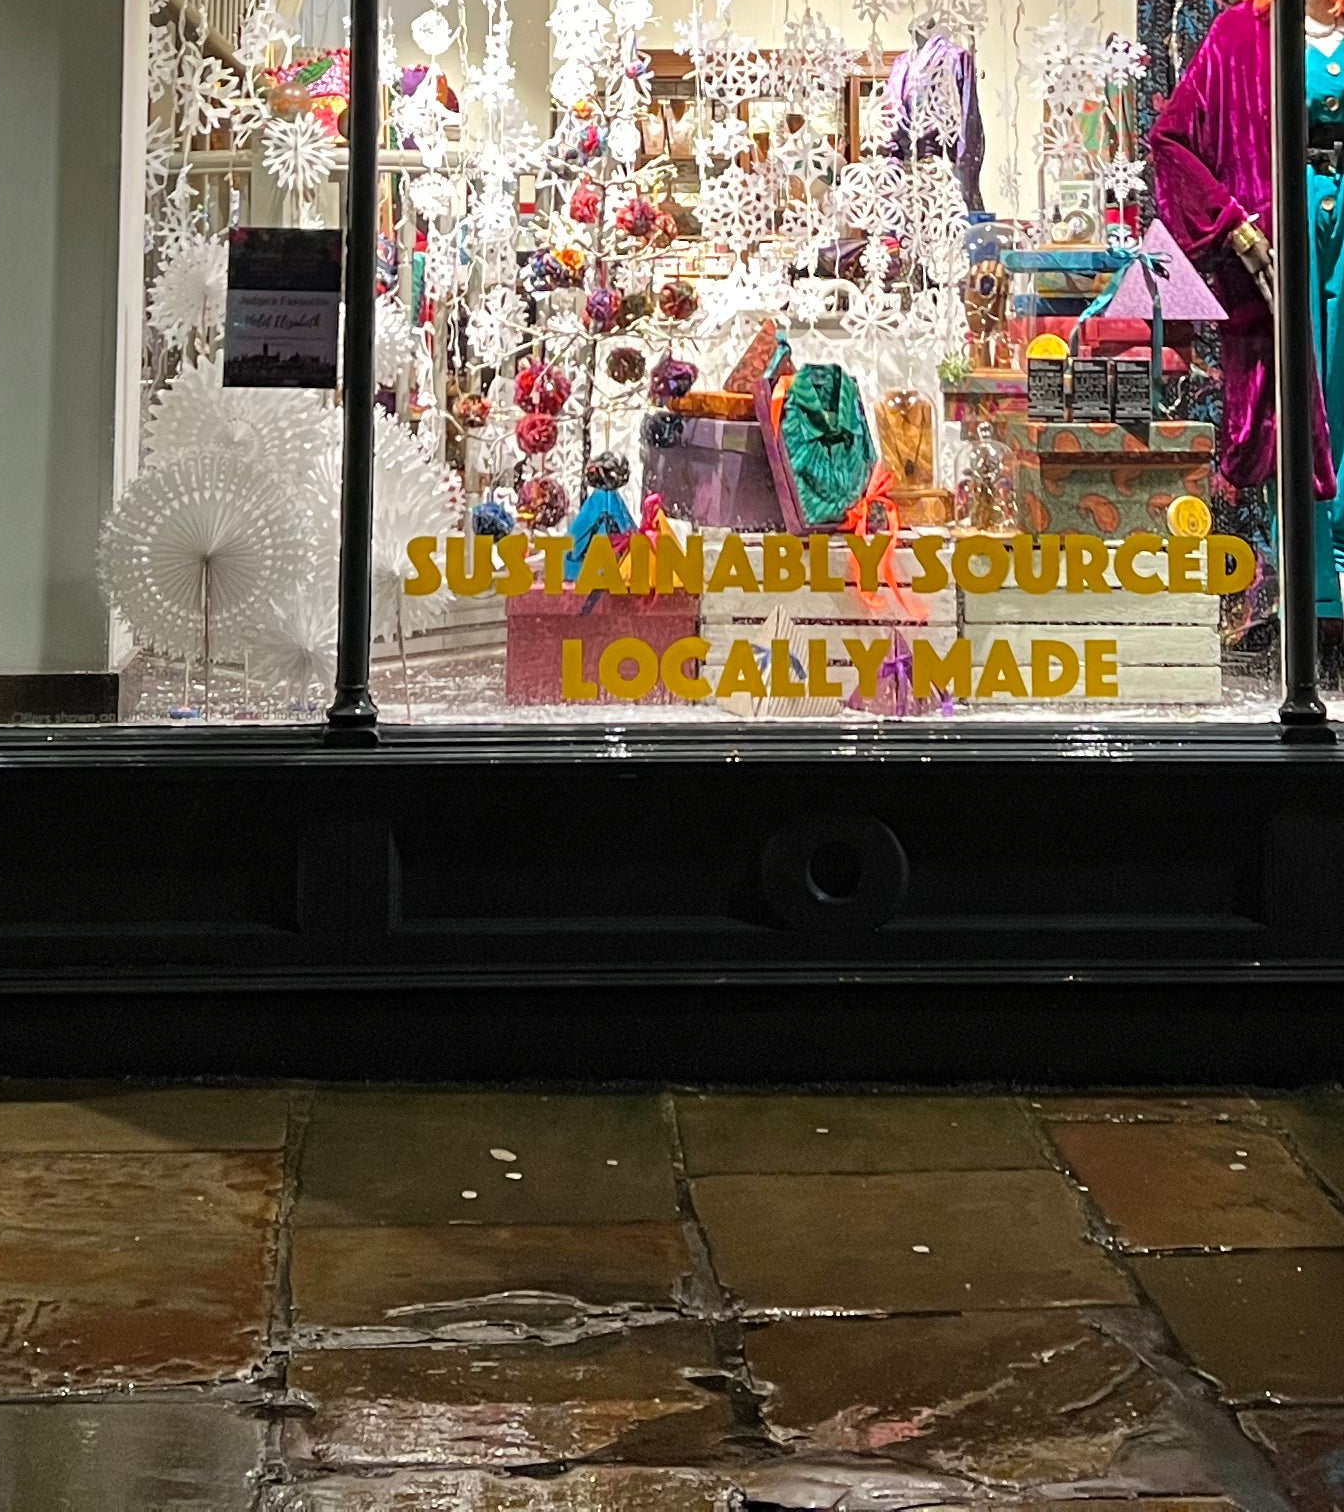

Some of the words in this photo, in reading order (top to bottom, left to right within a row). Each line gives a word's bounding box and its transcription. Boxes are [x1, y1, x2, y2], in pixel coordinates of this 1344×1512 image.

[404, 534, 892, 596] SUSTAINABLY
[911, 534, 1256, 596] SOURCED
[561, 637, 892, 700] LOCALLY
[913, 639, 1118, 699] MADE
